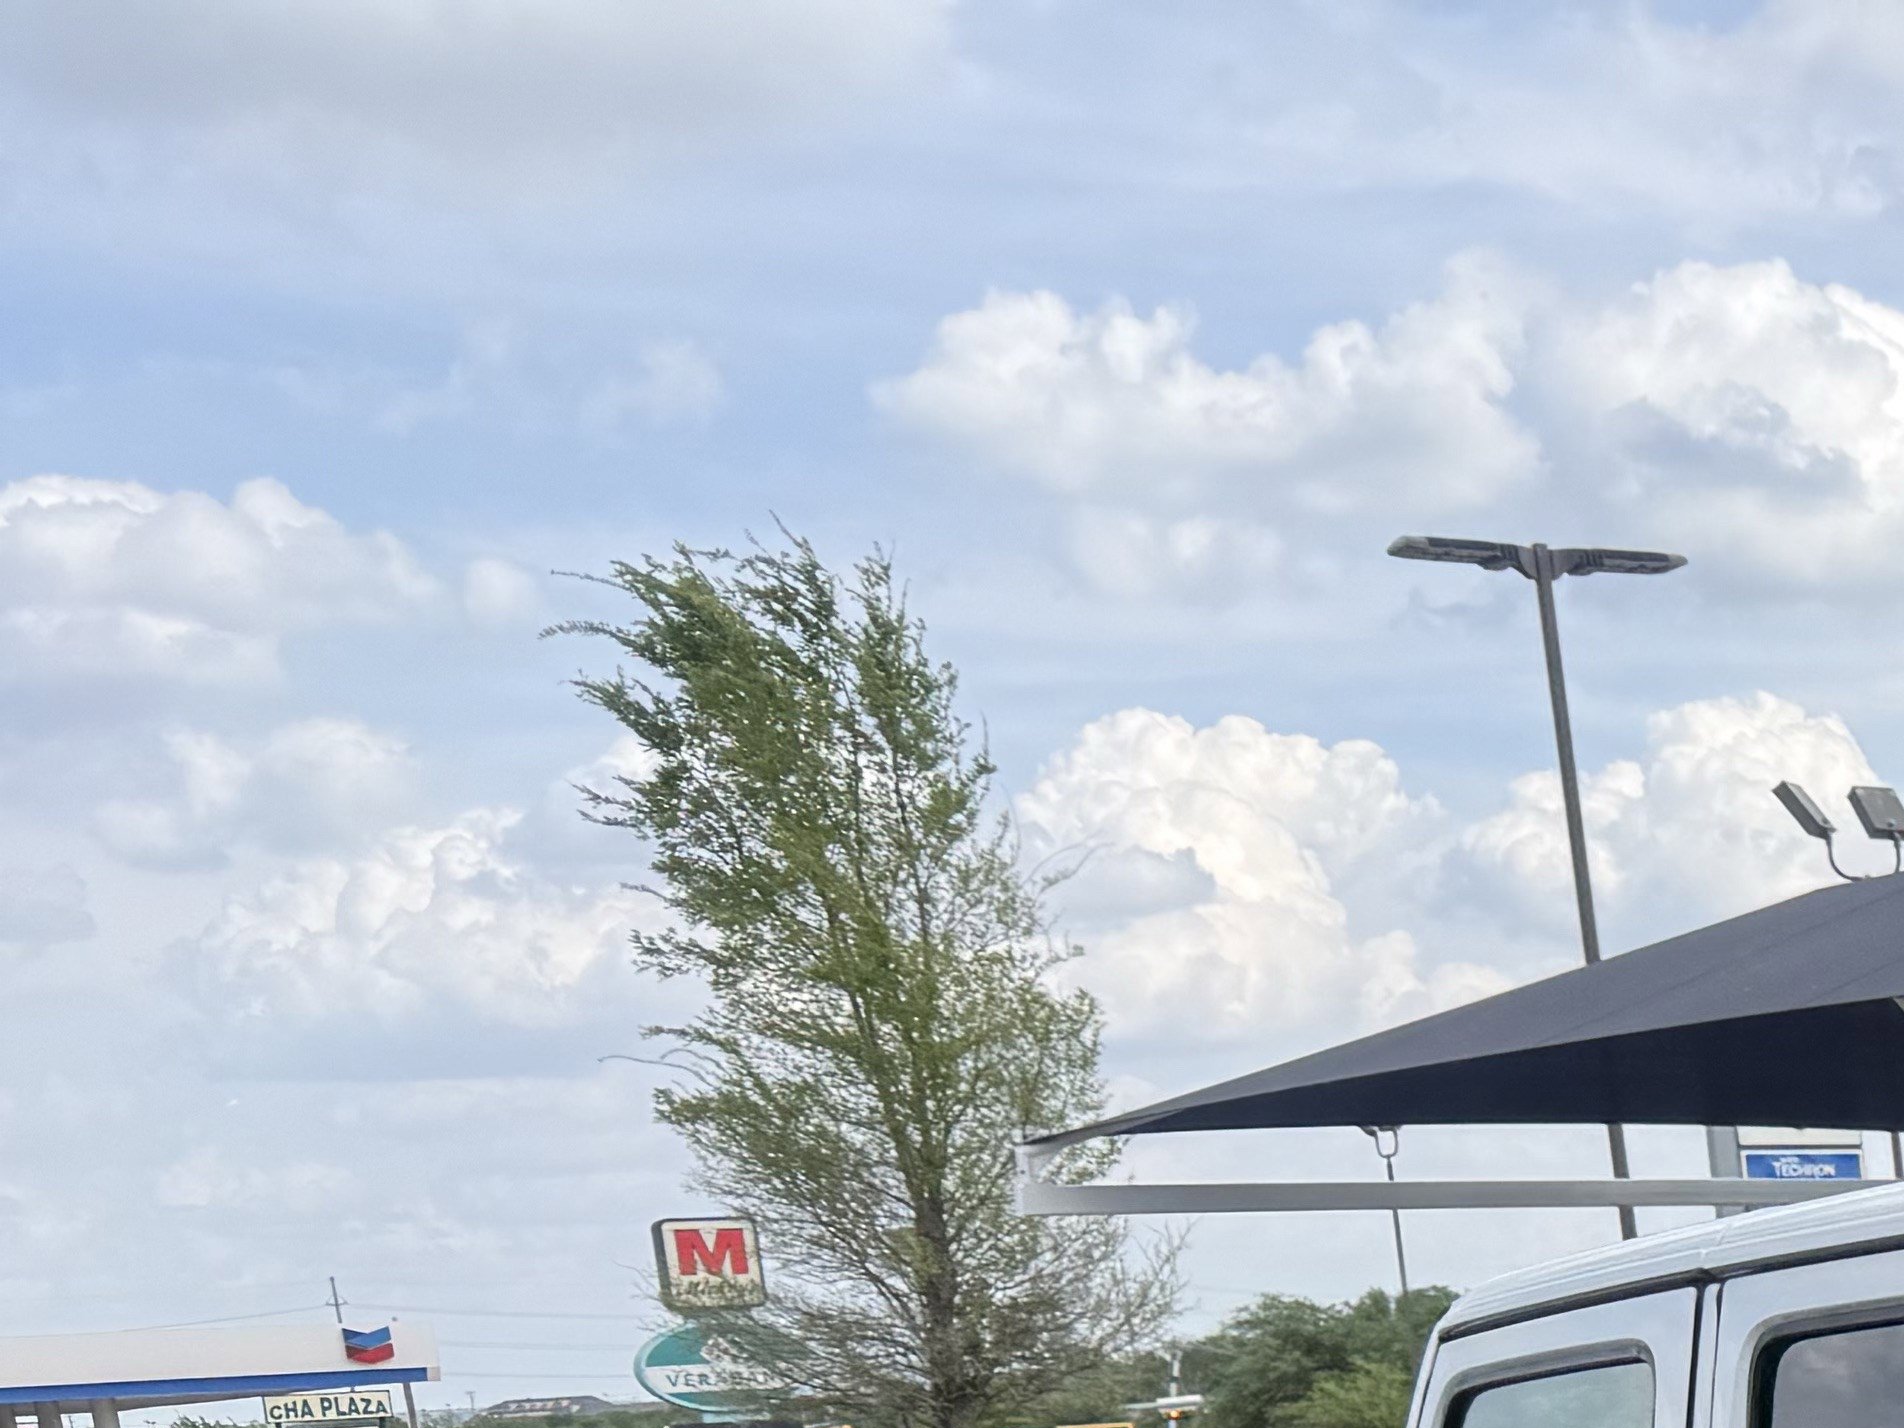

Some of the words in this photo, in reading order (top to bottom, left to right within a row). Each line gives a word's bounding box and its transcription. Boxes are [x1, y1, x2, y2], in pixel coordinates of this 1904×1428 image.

[674, 1227, 749, 1276] M
[268, 1398, 315, 1420] CHA
[319, 1396, 389, 1417] PLAZA
